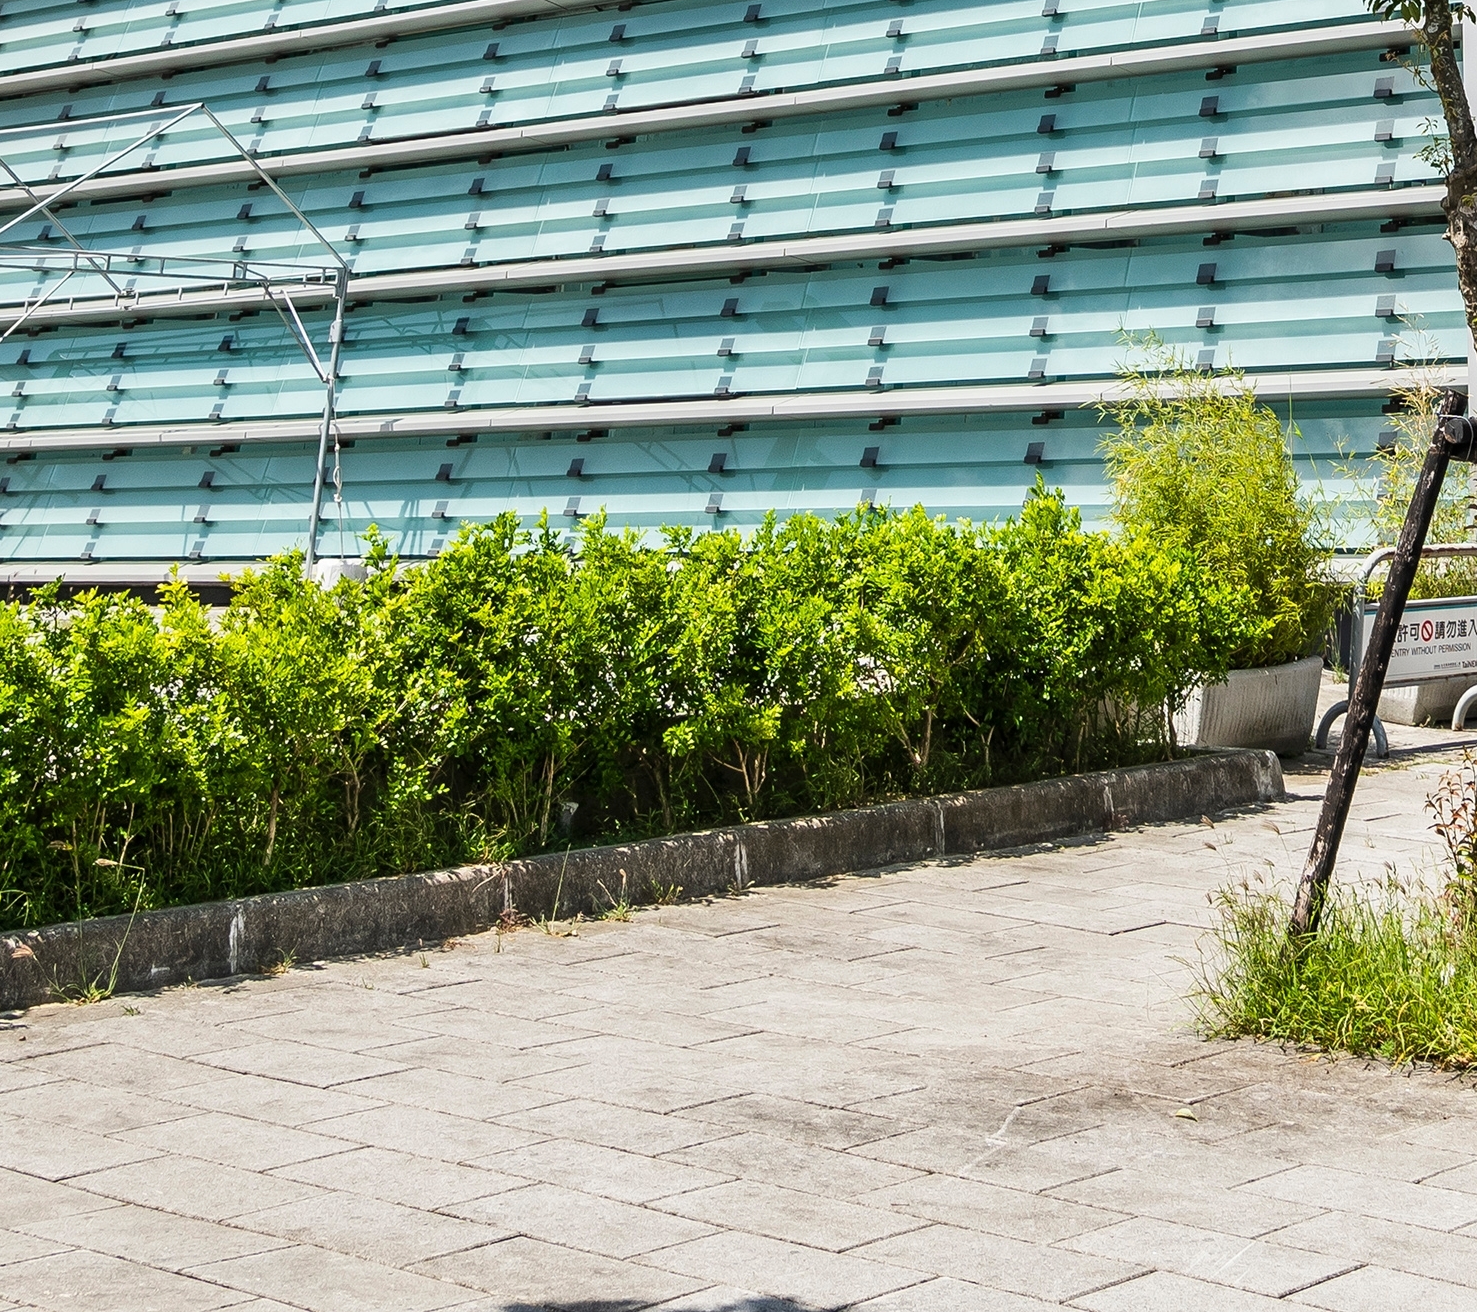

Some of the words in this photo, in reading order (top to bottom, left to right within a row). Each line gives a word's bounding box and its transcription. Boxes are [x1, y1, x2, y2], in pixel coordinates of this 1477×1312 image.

[1394, 622, 1421, 643] 許可
[1391, 647, 1410, 658] ENTRY
[1411, 644, 1437, 656] WITHOUT
[1438, 641, 1472, 653] PERMISSION
